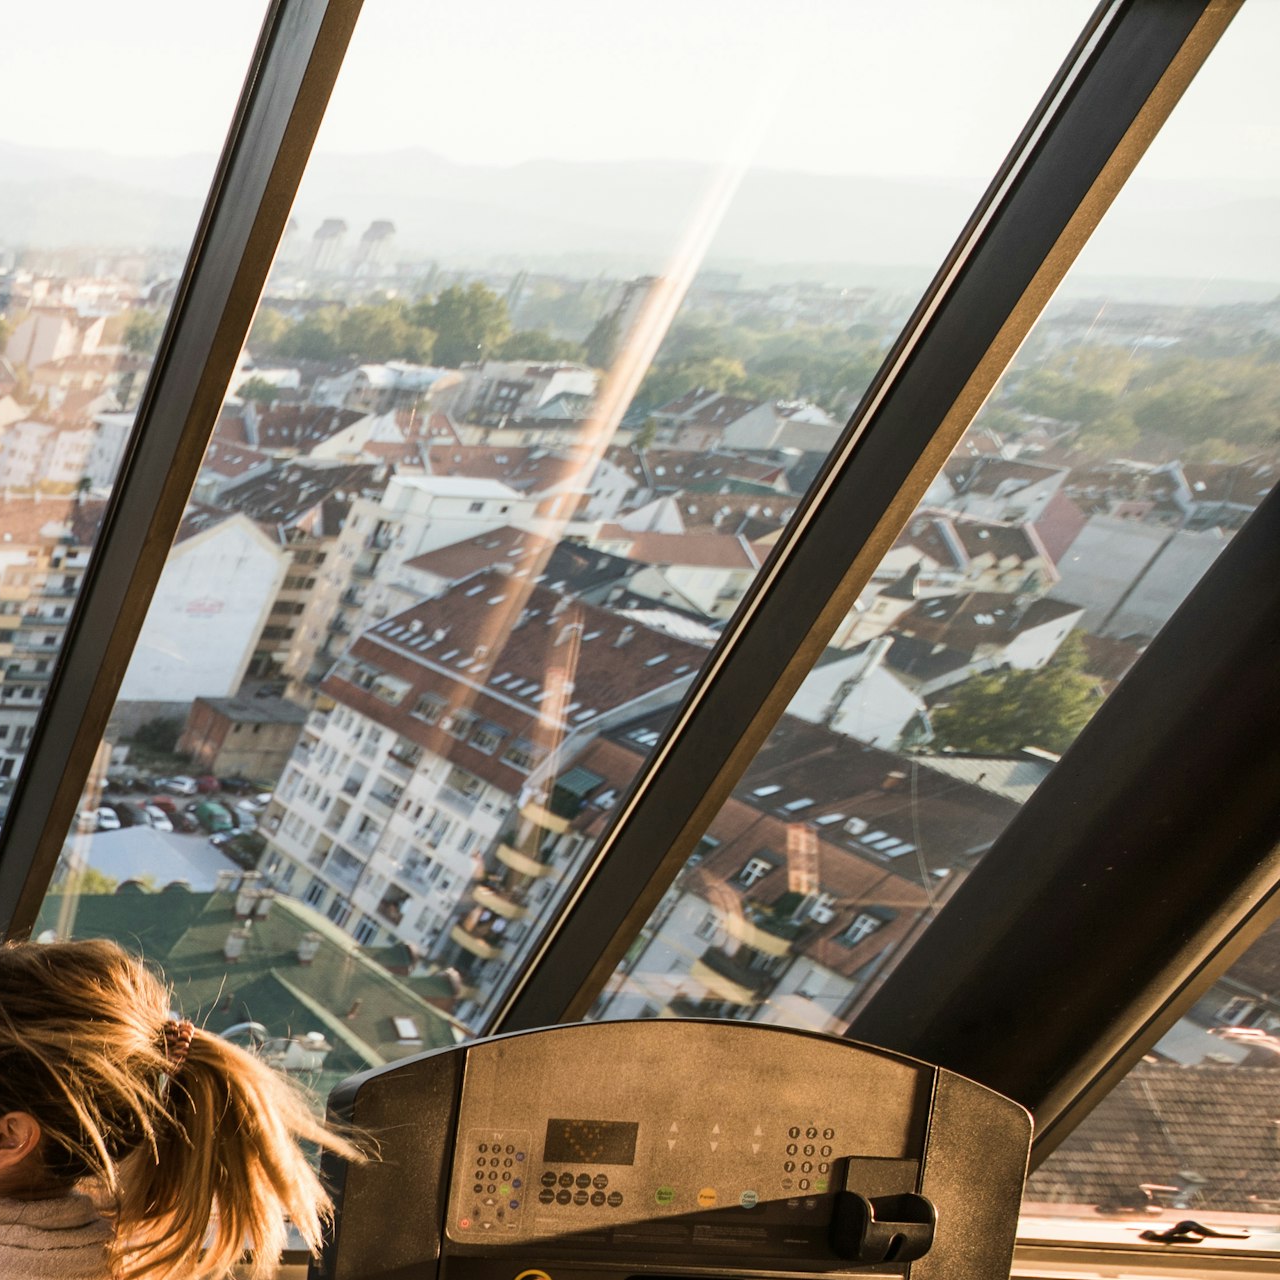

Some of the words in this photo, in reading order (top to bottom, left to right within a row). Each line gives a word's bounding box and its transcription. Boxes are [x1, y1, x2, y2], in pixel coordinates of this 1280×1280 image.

[792, 1129, 796, 1137] 1
[826, 1130, 832, 1138] 3
[789, 1146, 795, 1154] 4
[806, 1146, 812, 1154] 5
[823, 1147, 829, 1155] 6
[787, 1163, 792, 1171] 7
[804, 1163, 810, 1171] 8
[821, 1164, 827, 1172] 9
